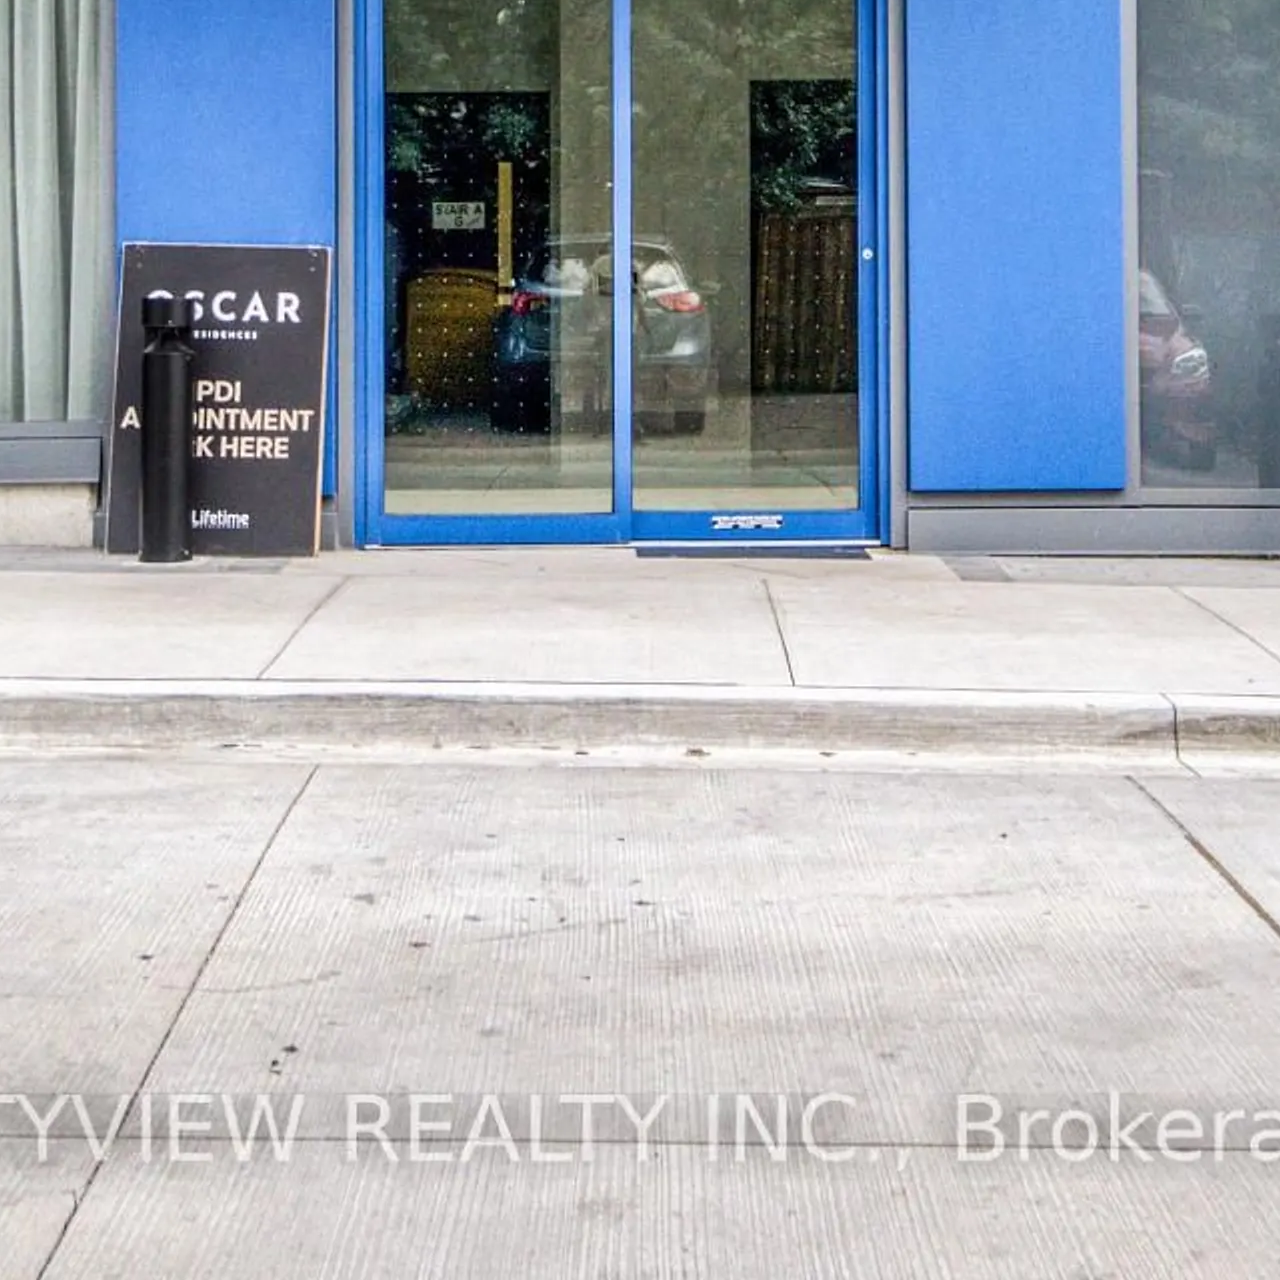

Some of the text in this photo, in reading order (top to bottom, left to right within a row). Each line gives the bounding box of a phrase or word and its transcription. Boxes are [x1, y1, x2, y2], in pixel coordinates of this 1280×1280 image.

[148, 290, 301, 323] SCAR
[197, 380, 242, 403] PDI
[120, 406, 315, 432] AINTMENT
[220, 437, 289, 459] HERE
[191, 509, 250, 525] Lifetime
